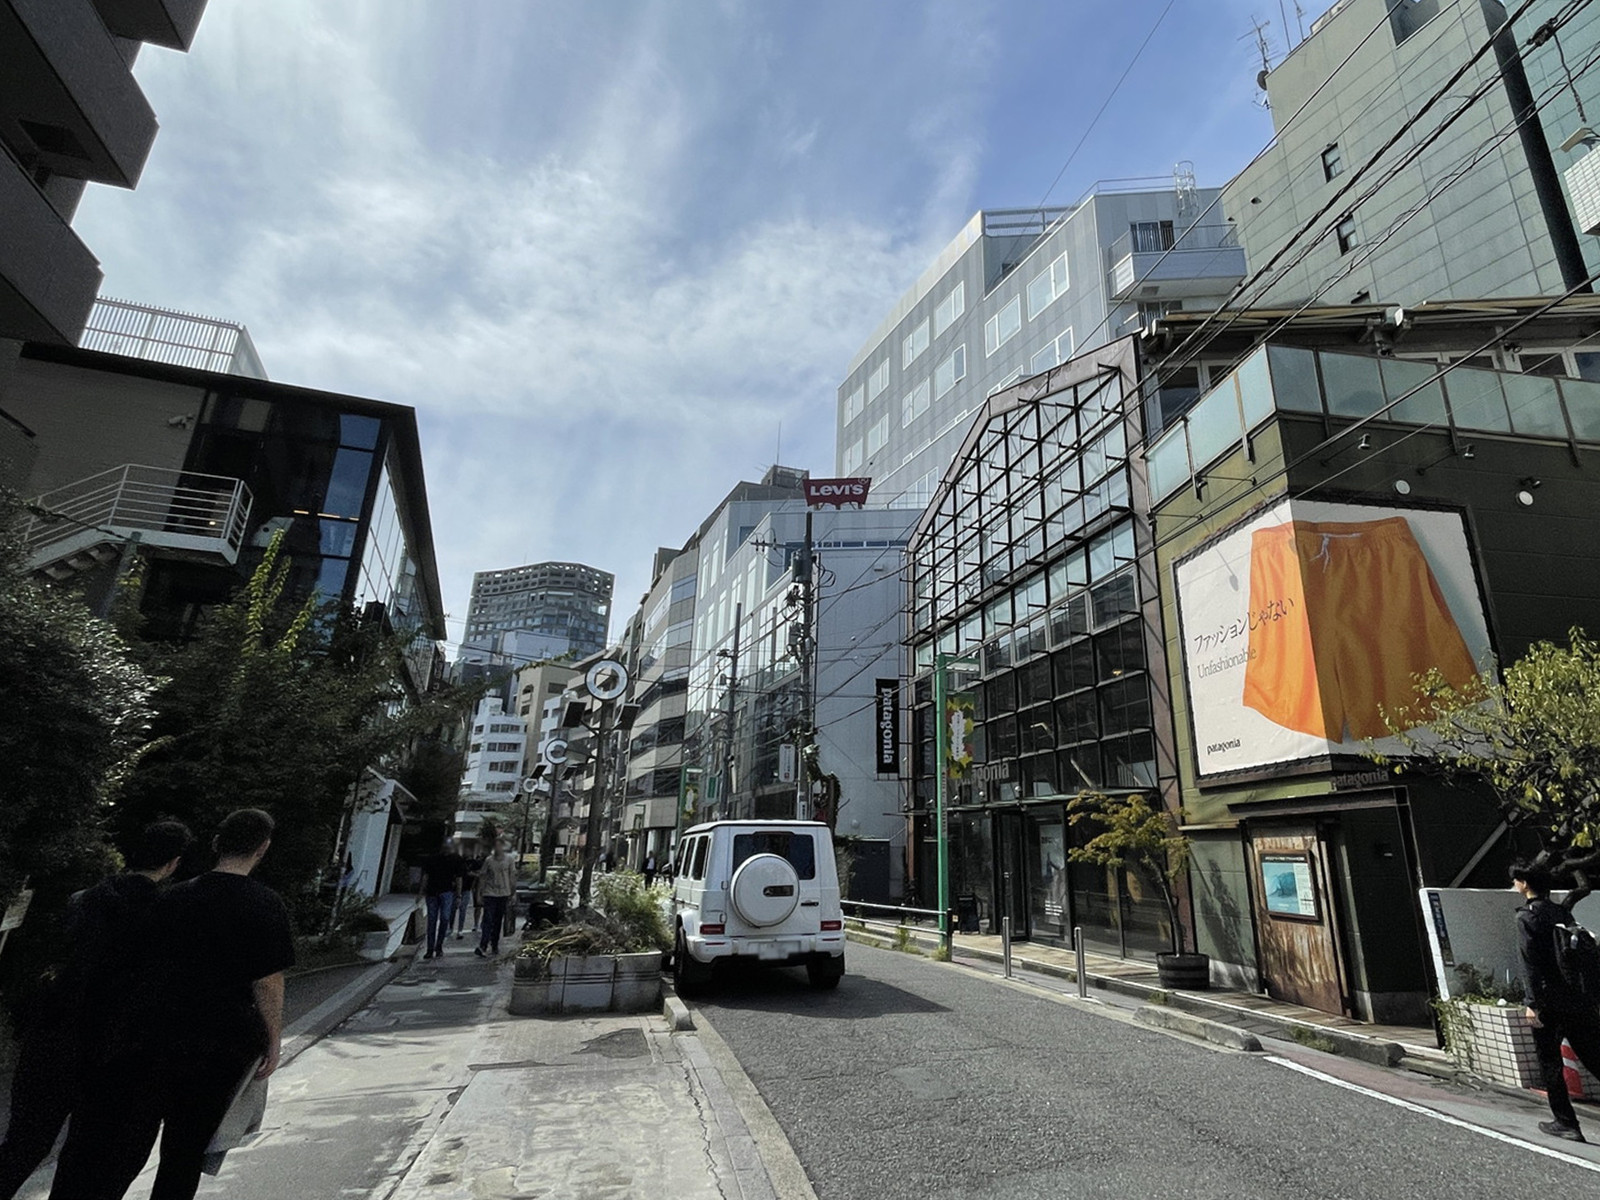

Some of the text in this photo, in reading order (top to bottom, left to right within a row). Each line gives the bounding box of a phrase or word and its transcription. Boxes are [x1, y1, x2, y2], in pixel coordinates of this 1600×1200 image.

[1194, 598, 1294, 655] ファッションじゃない
[1197, 645, 1257, 679] Unfashionable
[880, 687, 894, 764] patagonia
